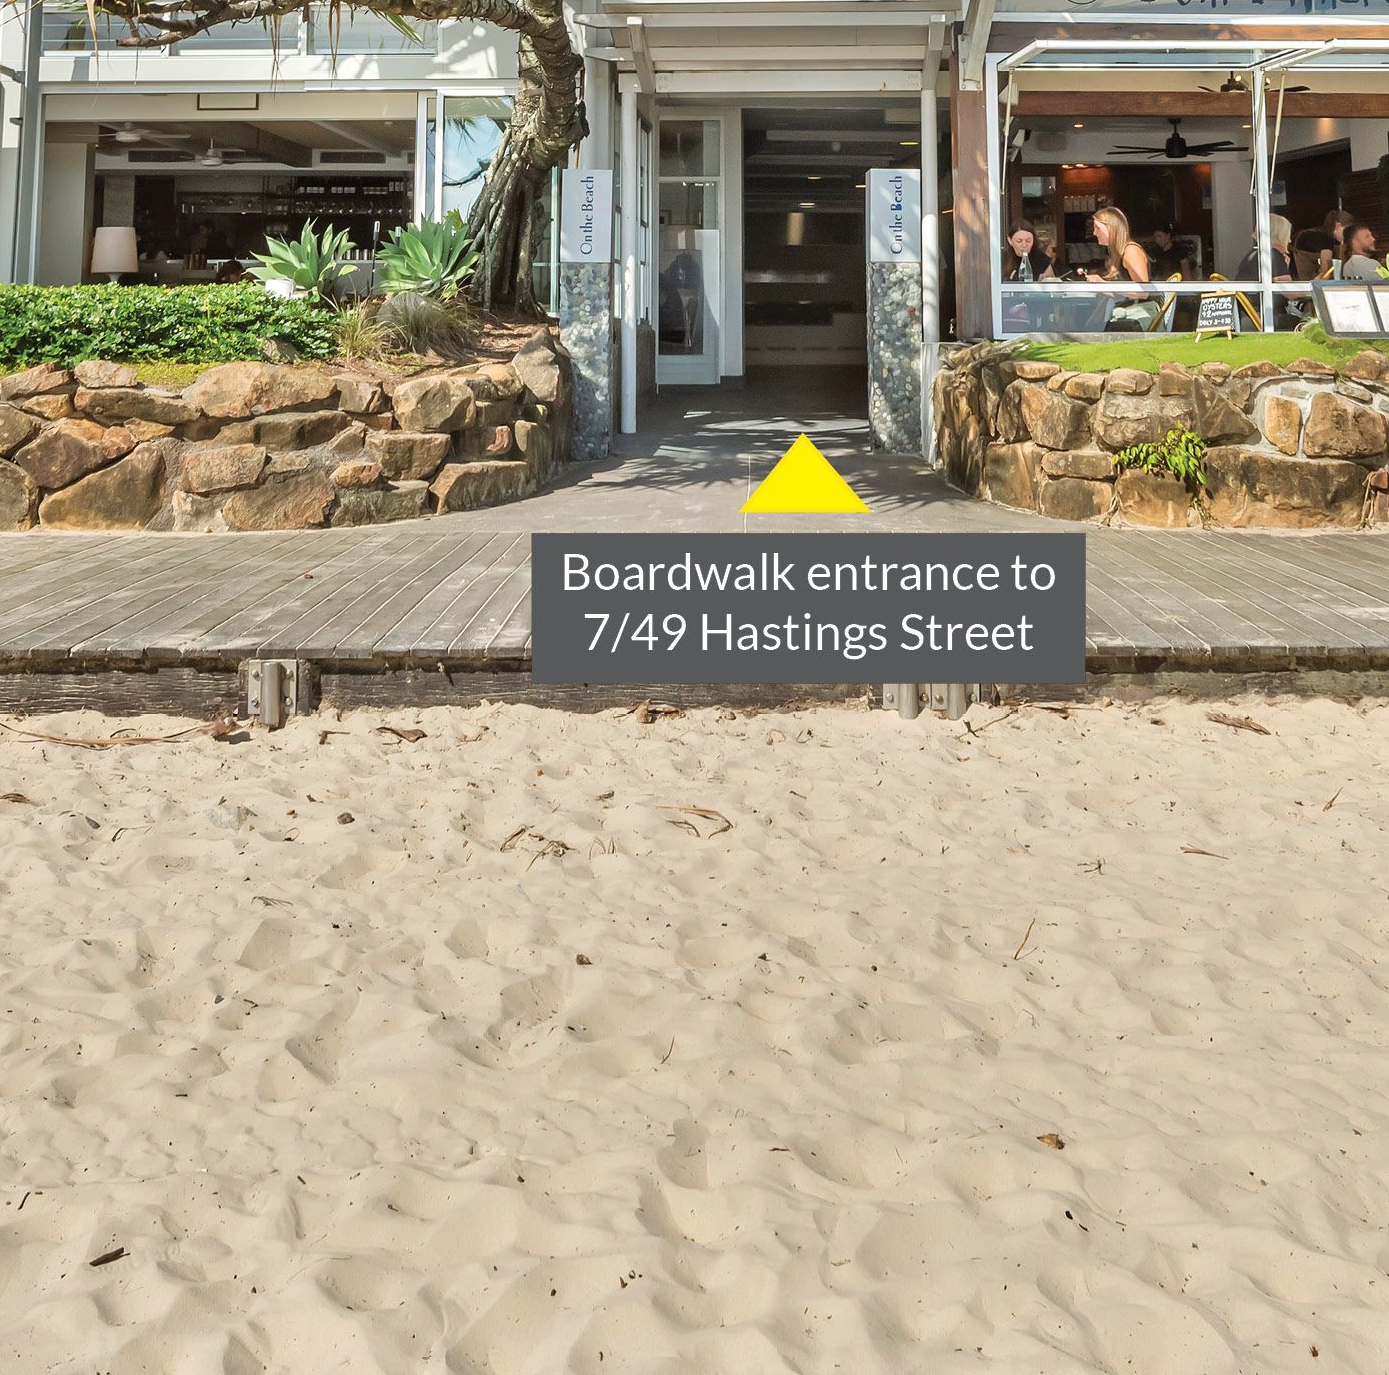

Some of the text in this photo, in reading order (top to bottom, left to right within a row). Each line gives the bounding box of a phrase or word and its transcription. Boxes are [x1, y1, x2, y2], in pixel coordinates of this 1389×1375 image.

[579, 176, 595, 255] On the Beach
[889, 176, 903, 255] On the Beach
